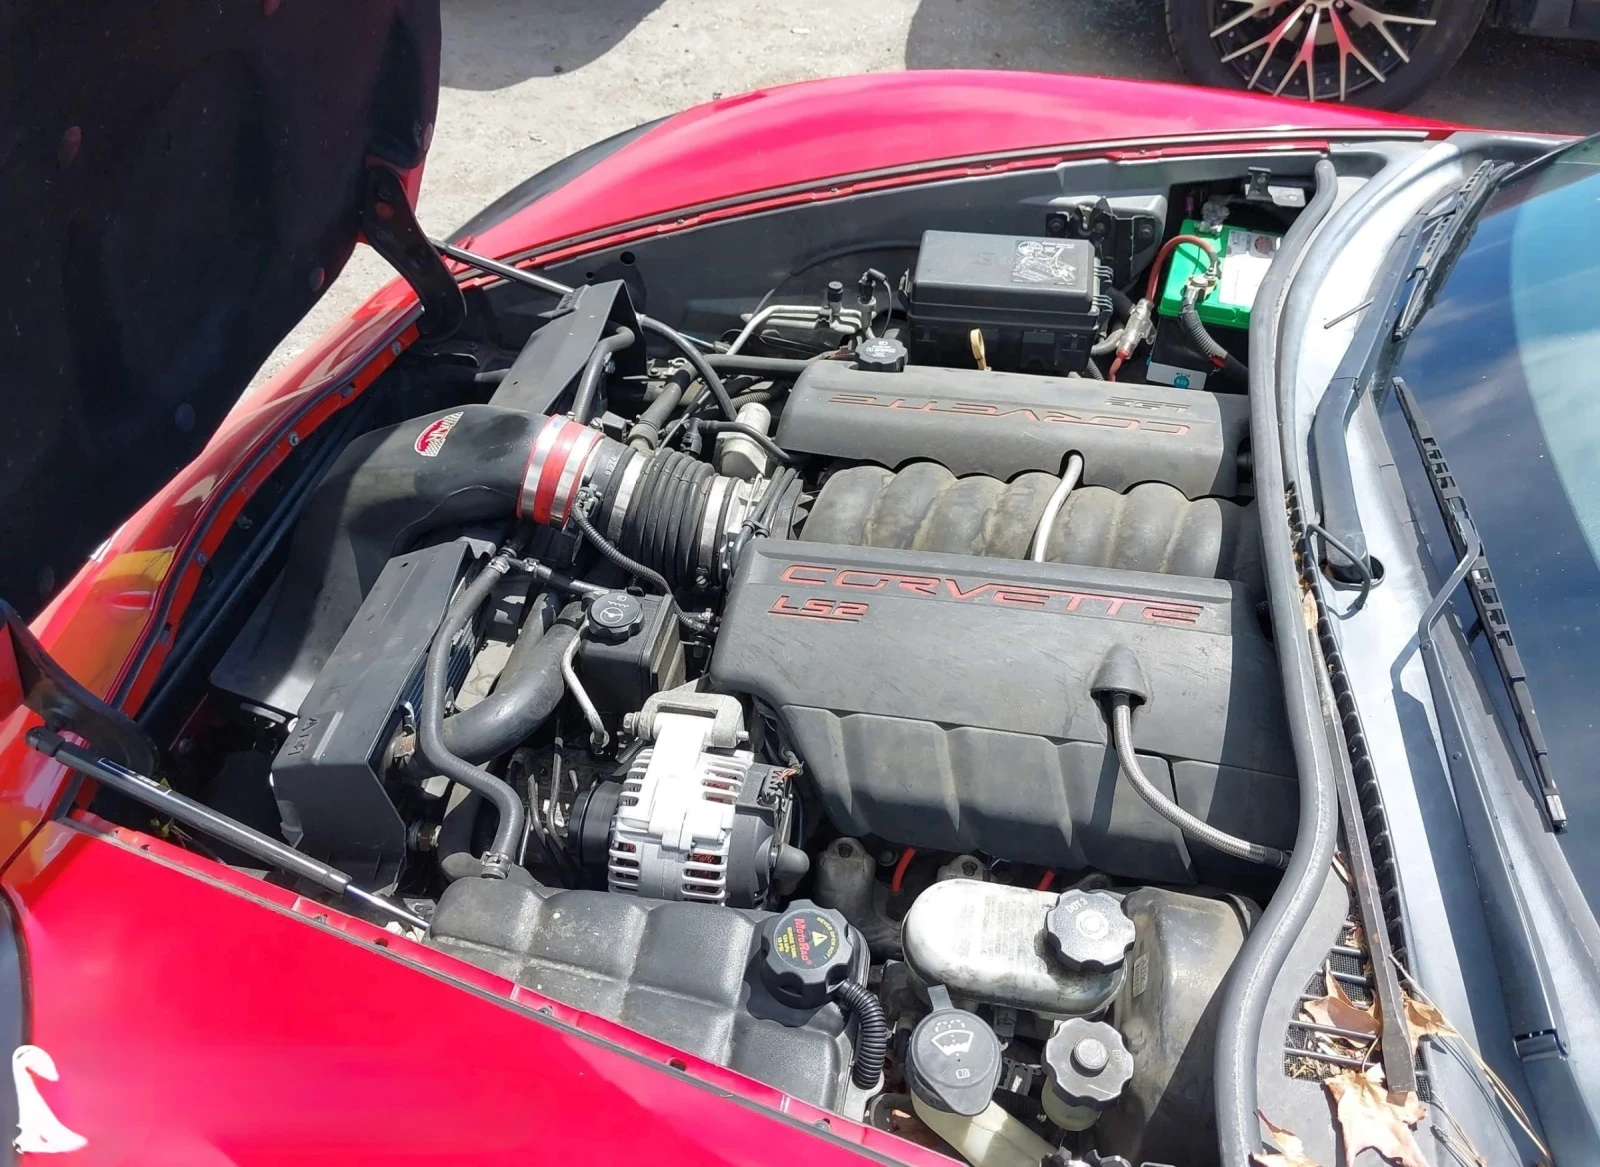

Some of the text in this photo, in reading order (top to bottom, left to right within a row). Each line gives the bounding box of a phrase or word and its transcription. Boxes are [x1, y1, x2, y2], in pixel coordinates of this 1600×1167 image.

[828, 394, 1191, 435] CORVETTE
[1103, 397, 1191, 414] LS2
[768, 594, 870, 621] LS2
[779, 564, 1204, 625] CORVETTE
[1064, 897, 1088, 913] DOT 3
[816, 916, 833, 931] NEVER
[828, 930, 837, 947] OPEN
